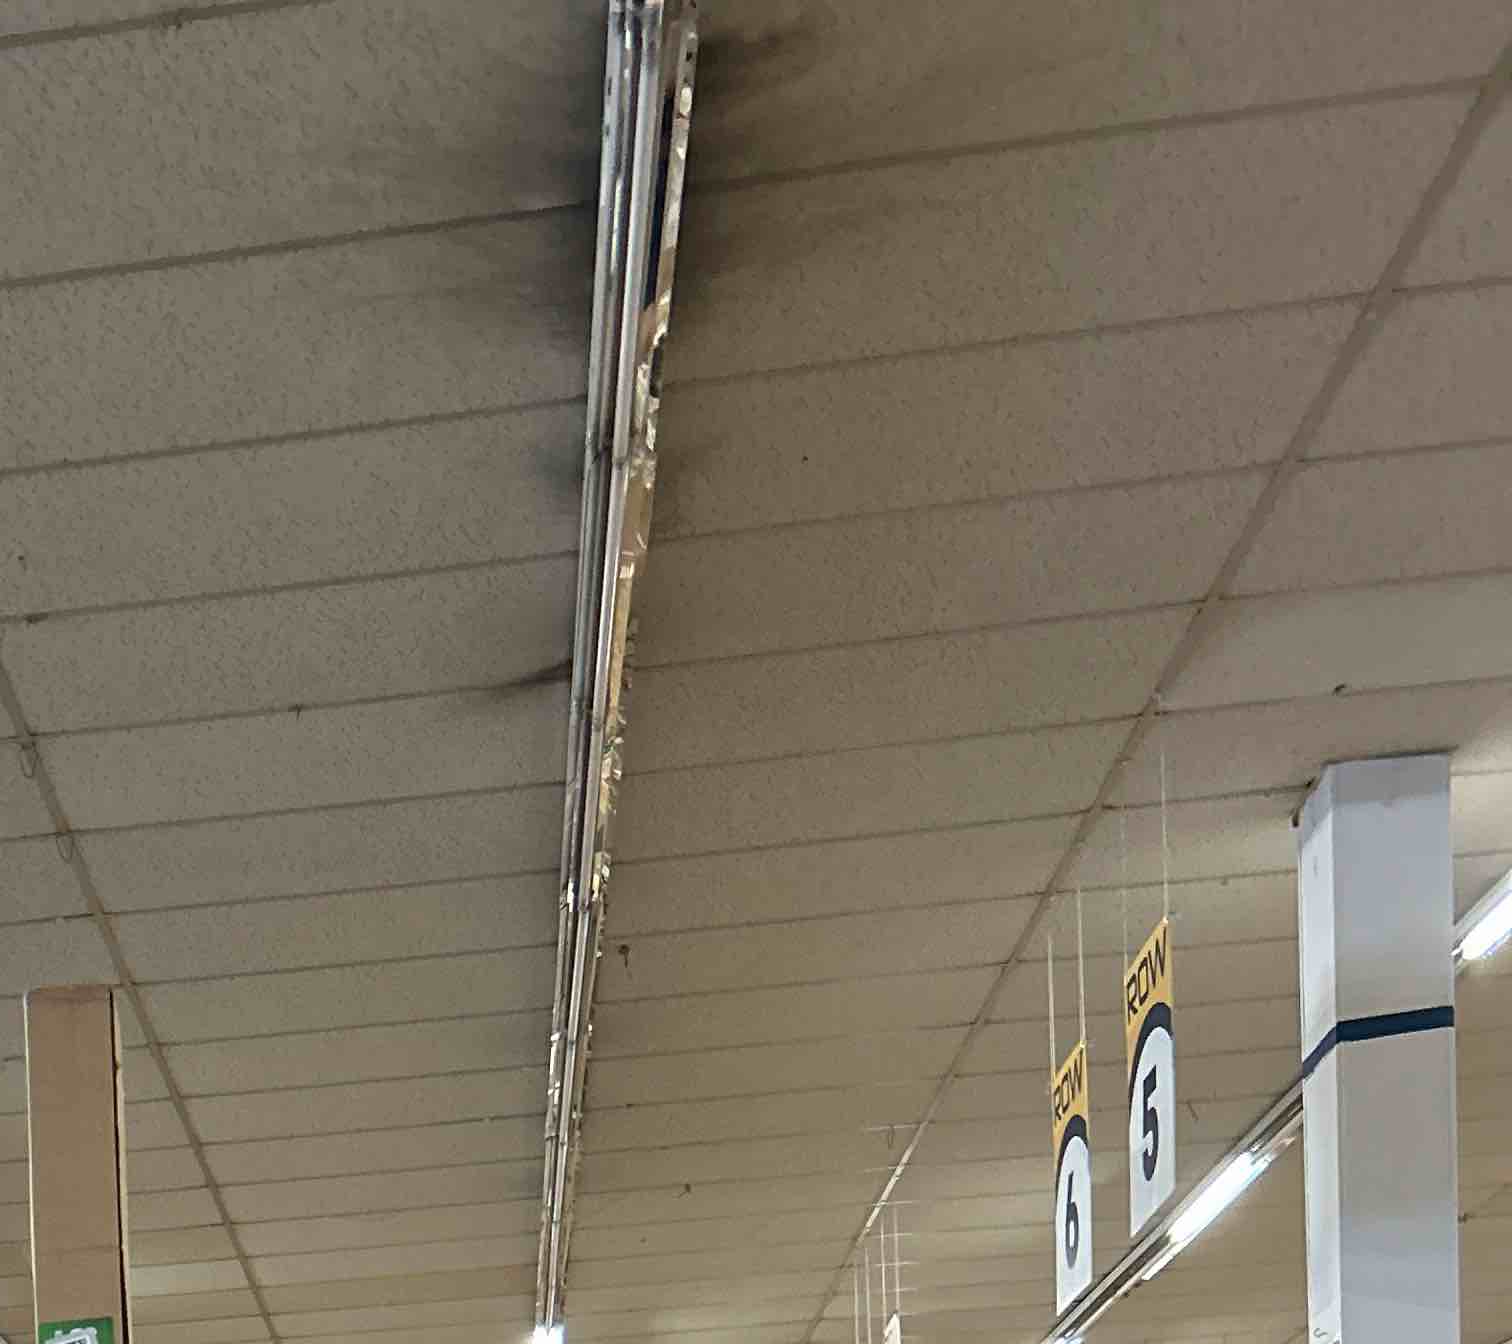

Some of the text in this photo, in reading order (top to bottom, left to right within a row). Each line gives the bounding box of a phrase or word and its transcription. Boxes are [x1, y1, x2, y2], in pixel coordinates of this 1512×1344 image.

[1126, 927, 1168, 1016] ROW
[1053, 1046, 1085, 1121] ROW
[1141, 1065, 1160, 1181] 5
[1064, 1170, 1079, 1269] 6
